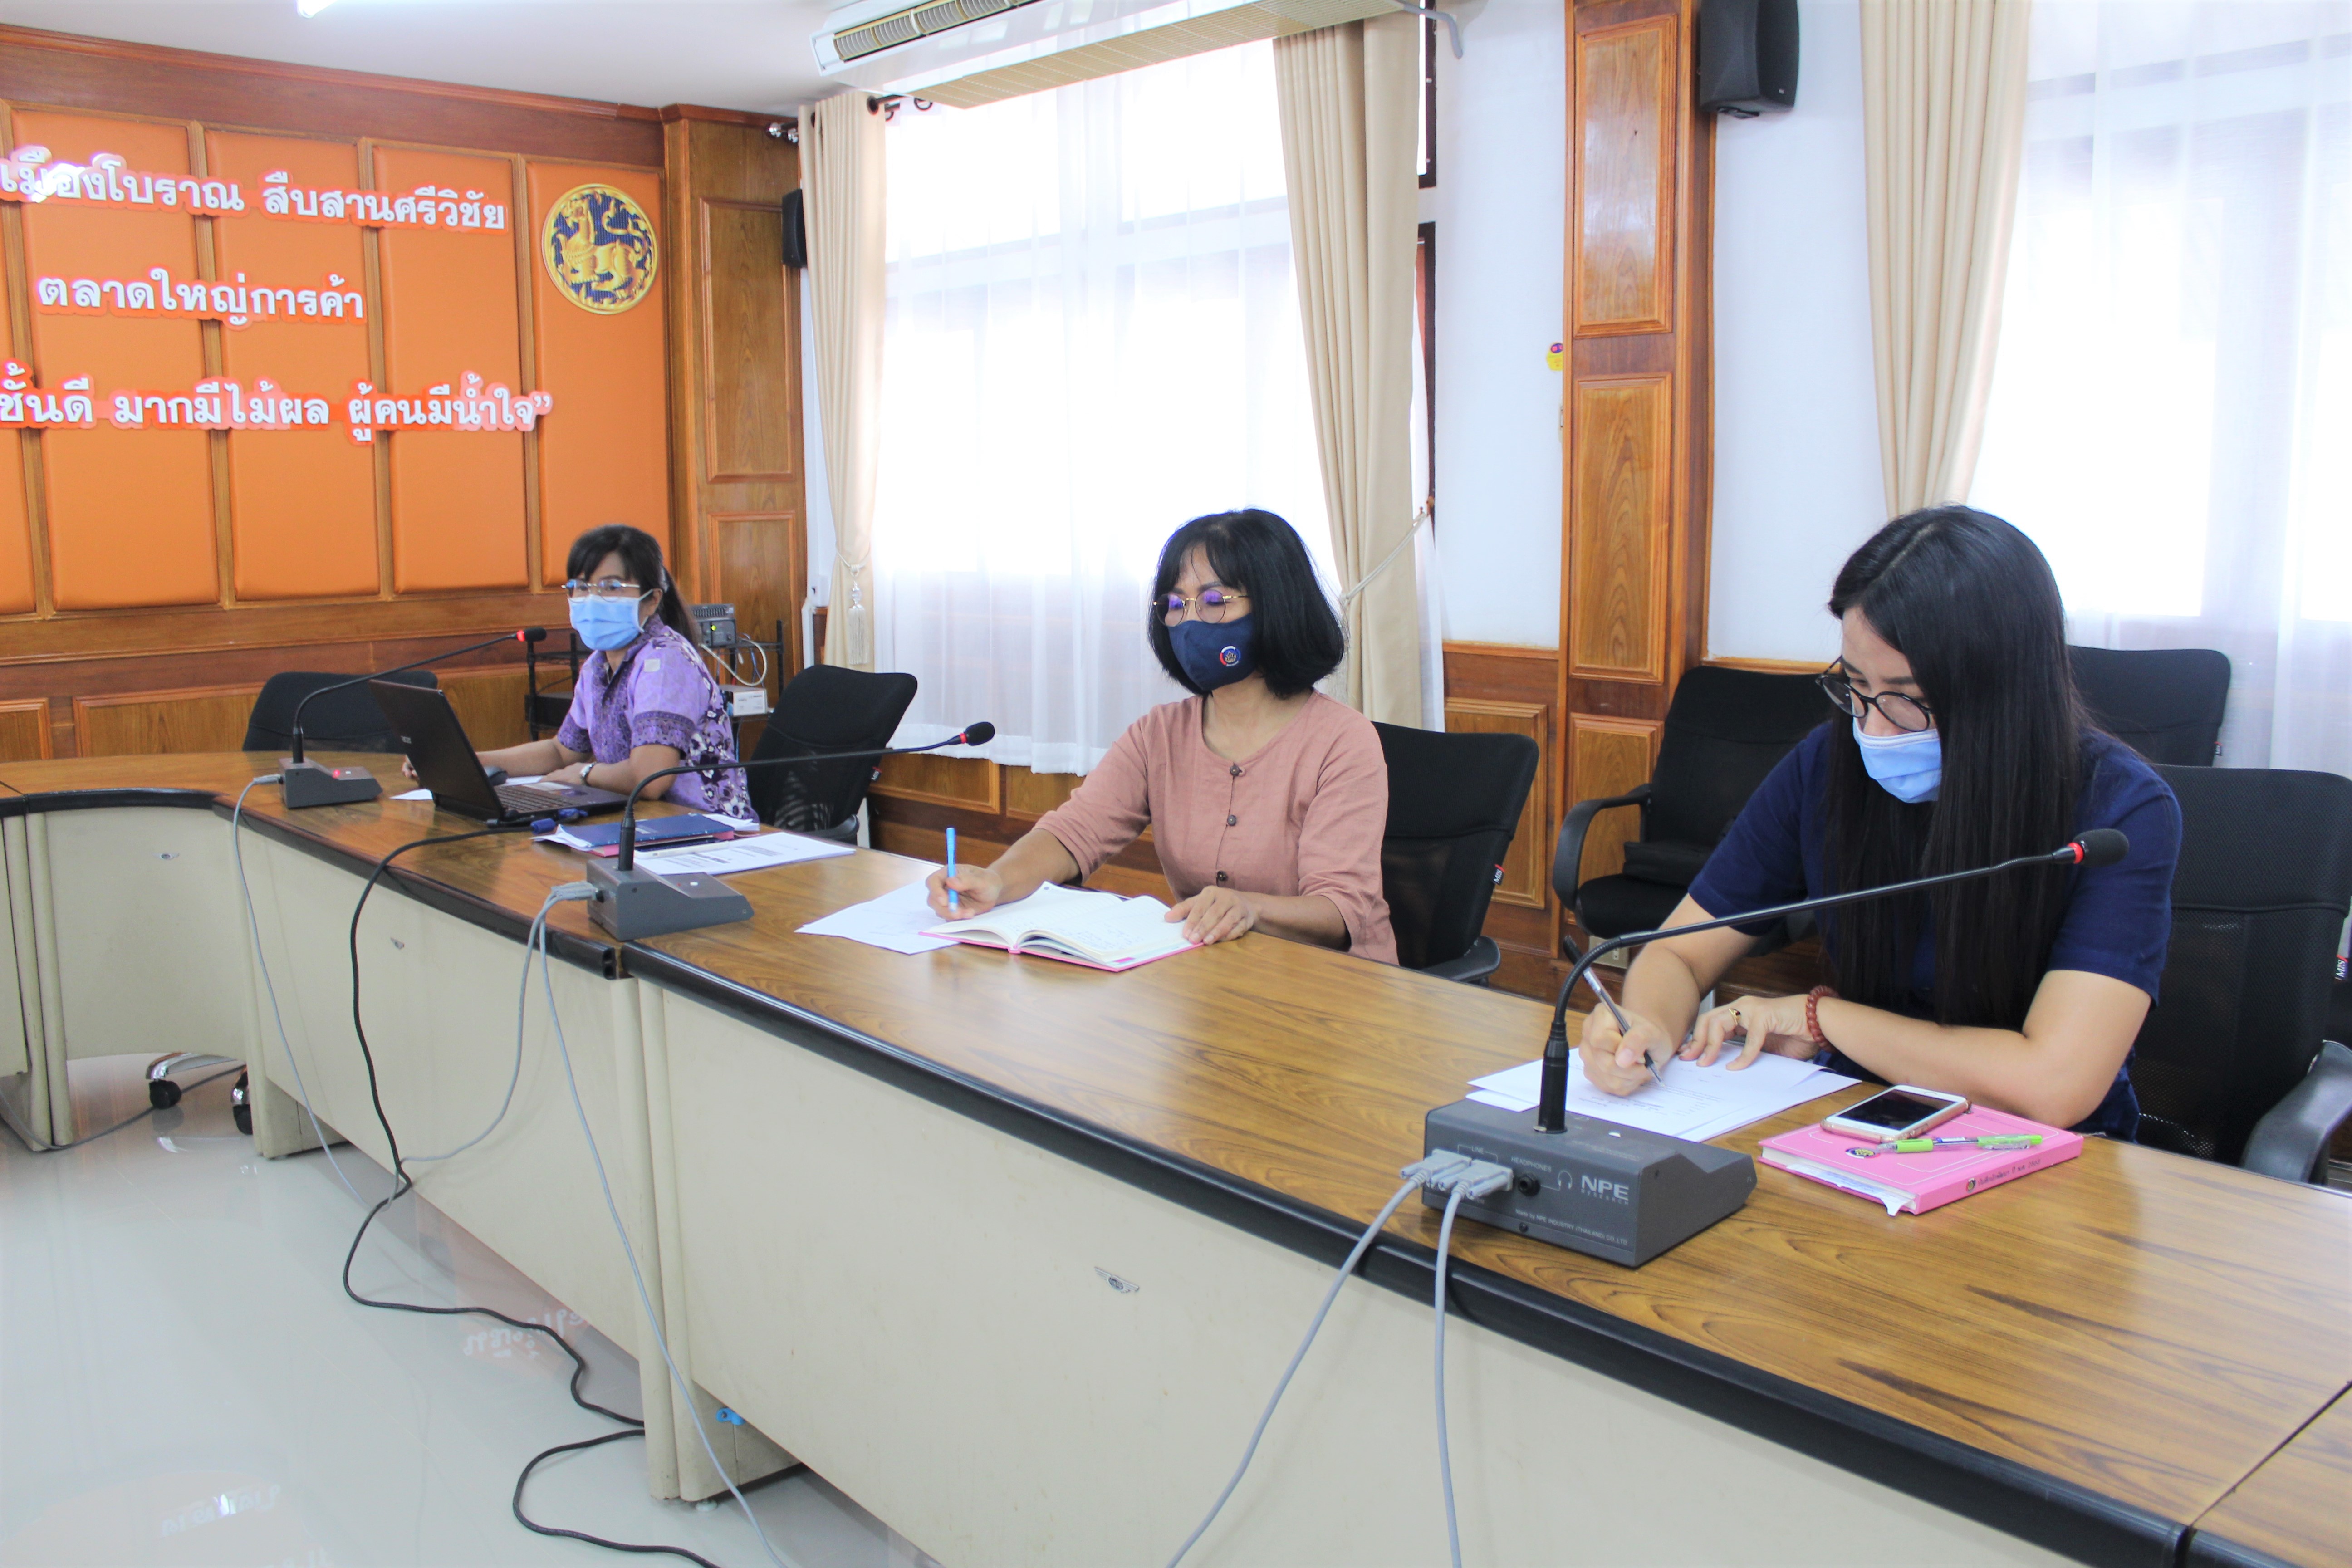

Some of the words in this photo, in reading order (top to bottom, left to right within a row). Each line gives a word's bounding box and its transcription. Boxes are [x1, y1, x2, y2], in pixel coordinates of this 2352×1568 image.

[263, 172, 504, 229] สืบสานศรีวิชัย
[37, 268, 363, 325] ตลาดใหญ่การค้า
[0, 363, 93, 422] ชั้นดี
[114, 381, 329, 424] มากมีไม้ผล
[1471, 1146, 1484, 1155] LINE
[1511, 1156, 1552, 1173] HEADPHONES
[1581, 1174, 1629, 1201] NPE
[1581, 1188, 1629, 1205] RESEARCH
[1536, 1215, 1546, 1223] NPE
[1548, 1218, 1574, 1230] INDUSTRY
